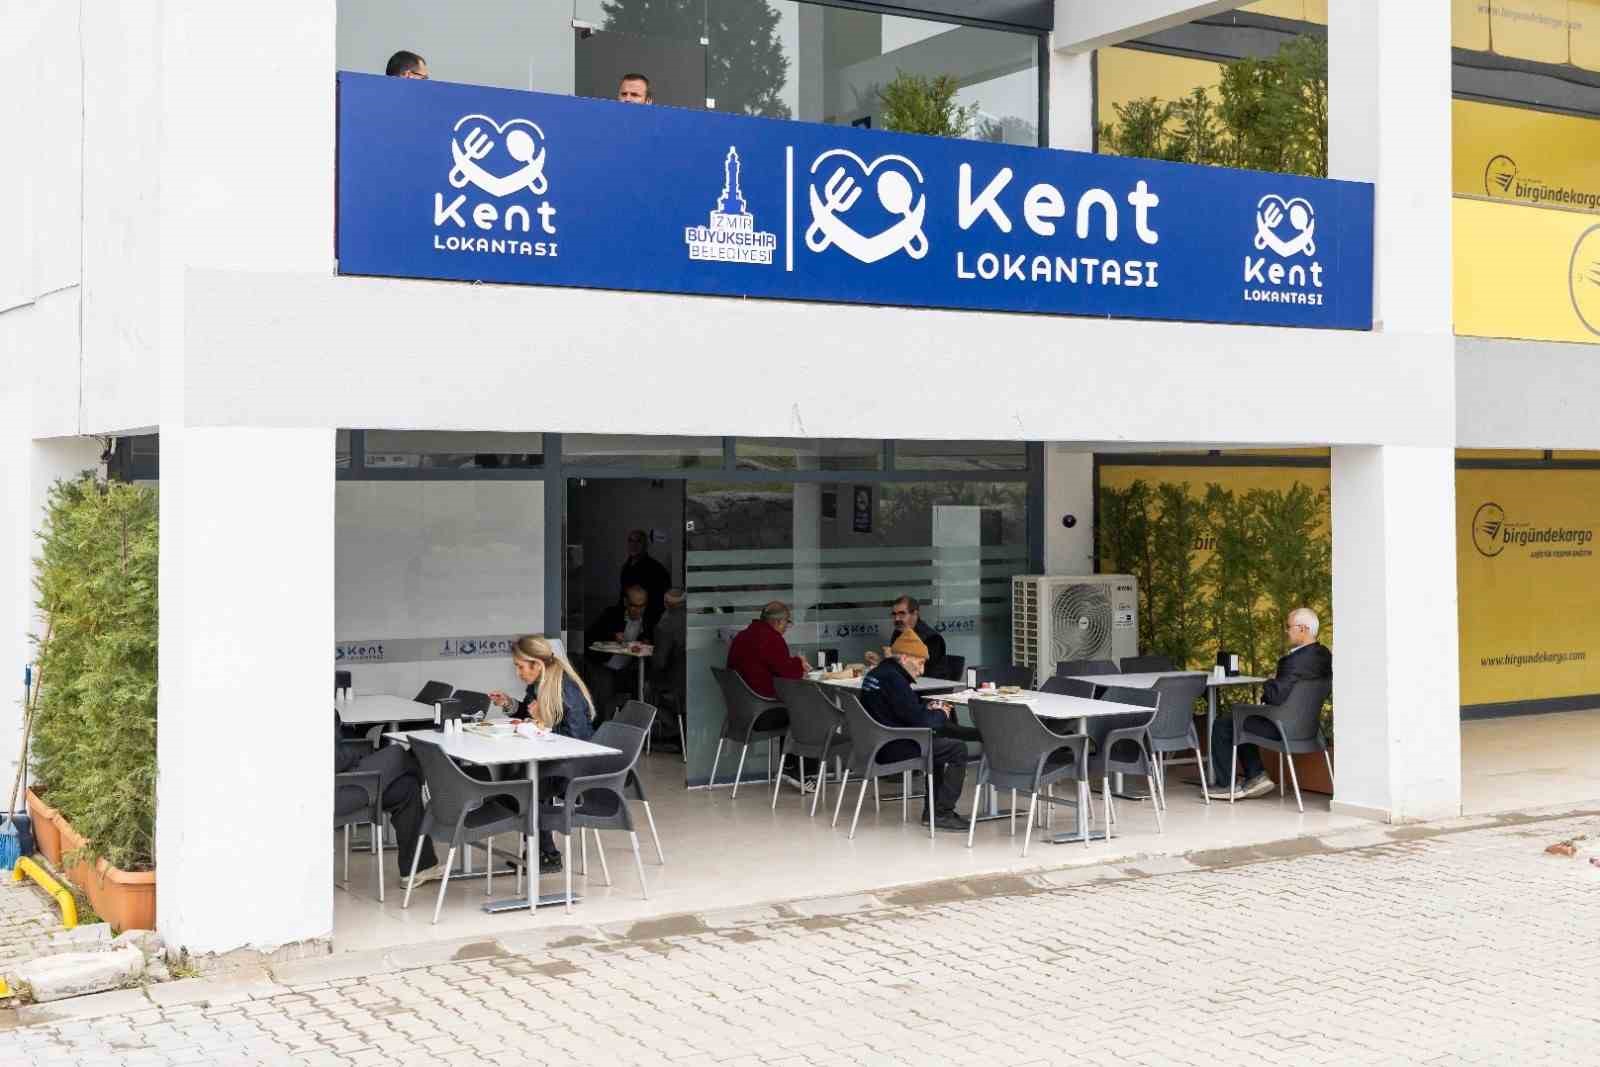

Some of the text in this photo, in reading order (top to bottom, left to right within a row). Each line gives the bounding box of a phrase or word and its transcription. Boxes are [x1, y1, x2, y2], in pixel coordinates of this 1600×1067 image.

[434, 192, 557, 235] Kent
[958, 162, 1160, 246] Kent
[434, 235, 558, 257] LOKANTASI
[957, 251, 1159, 288] LOKANTASI
[1244, 255, 1323, 288] Kent
[1244, 289, 1323, 306] LOKANTASI
[1503, 527, 1593, 546] birgündekargo
[347, 644, 384, 656] Kent
